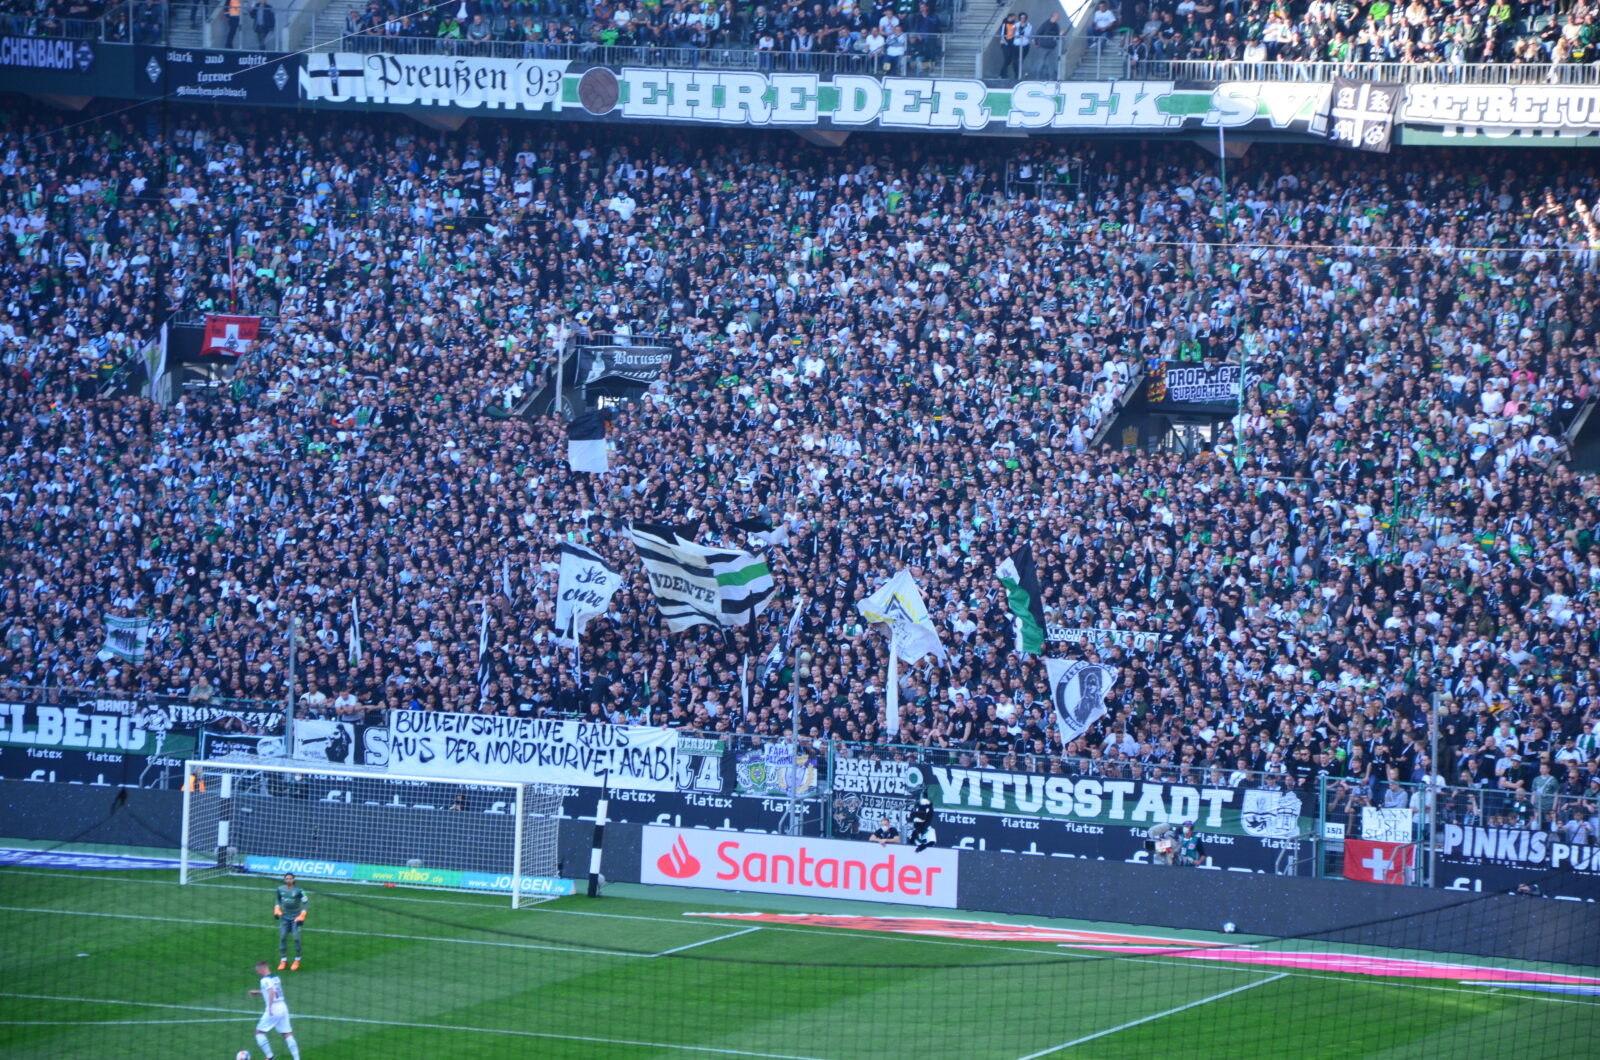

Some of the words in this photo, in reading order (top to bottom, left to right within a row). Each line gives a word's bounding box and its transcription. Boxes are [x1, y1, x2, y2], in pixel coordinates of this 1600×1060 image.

[0, 37, 74, 69] CHENBACH
[204, 54, 225, 64] and
[239, 54, 268, 67] white
[197, 71, 233, 82] forever
[367, 54, 507, 96] Preußen
[621, 68, 819, 125] EHRE
[832, 75, 989, 130] DER
[1007, 80, 1185, 129] SEK.
[1173, 382, 1232, 402] SUPPORTERS
[395, 710, 564, 743] BULLENSCHWEINE
[576, 722, 630, 749] RAUS
[27, 748, 63, 759] flatex
[86, 752, 122, 763] flatex
[391, 735, 436, 764] AUS
[445, 736, 480, 764] DER
[484, 739, 615, 777] NORDKURVE!
[618, 745, 676, 782] ACAB!
[834, 757, 909, 777] BEGLEIT
[832, 775, 906, 795] SERVICE
[608, 788, 656, 802] flatex
[685, 793, 733, 808] flatex
[932, 766, 1235, 828] VITUSSTADT
[938, 812, 977, 824] flatex
[1001, 818, 1040, 830] flatex
[1376, 818, 1401, 831] IST
[1065, 822, 1104, 835] flatex
[1364, 828, 1410, 841] SUPER
[1443, 823, 1548, 864] PINKIS
[273, 859, 335, 876] JONGEN
[716, 840, 942, 897] Santander
[490, 876, 552, 893] JOGEN
